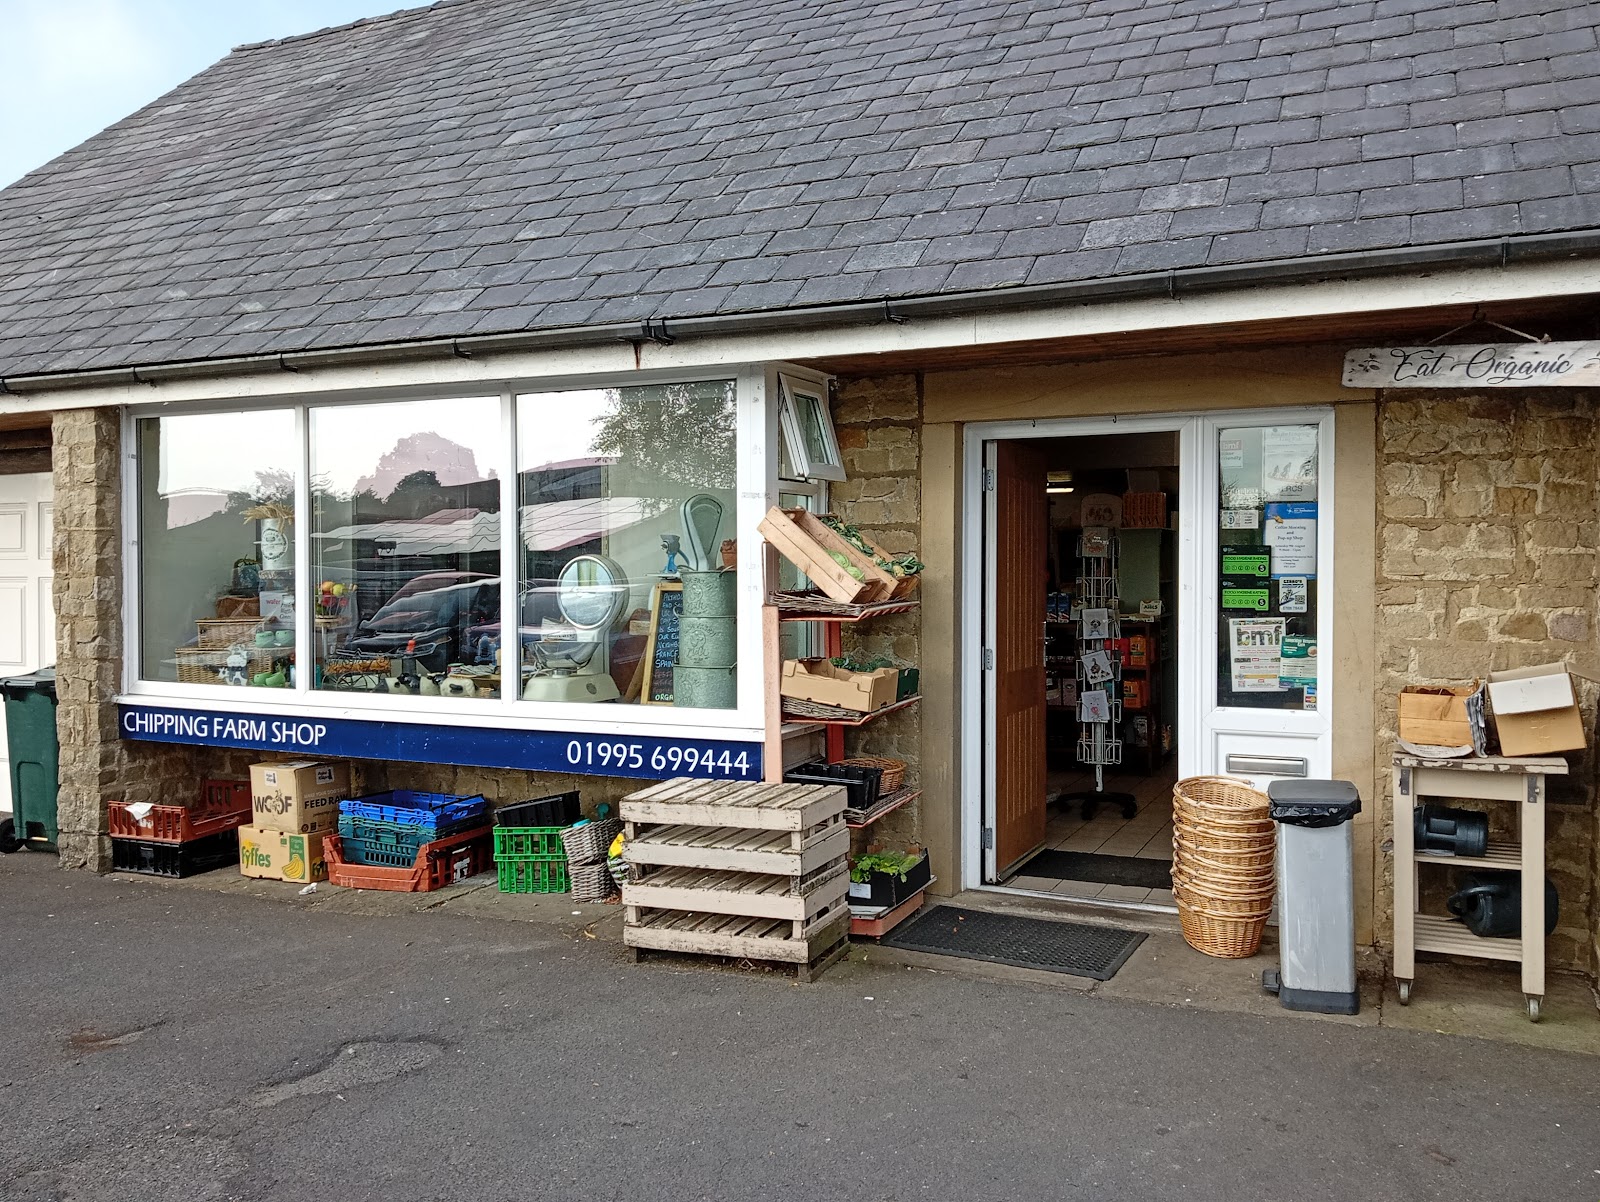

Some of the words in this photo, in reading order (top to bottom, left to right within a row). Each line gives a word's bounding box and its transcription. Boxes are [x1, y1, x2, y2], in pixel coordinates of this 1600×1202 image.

[1390, 348, 1454, 381] Eat
[1450, 347, 1573, 384] Organic
[1237, 626, 1282, 645] bmf
[124, 712, 208, 738] CHIPPING
[213, 717, 266, 742] FARM
[272, 721, 327, 746] SHOP
[566, 740, 643, 769] 01995
[651, 744, 750, 776] 699444
[254, 795, 292, 815] WOOF
[304, 798, 327, 809] FEED
[328, 793, 348, 805] RAW
[242, 846, 271, 868] fyffes
